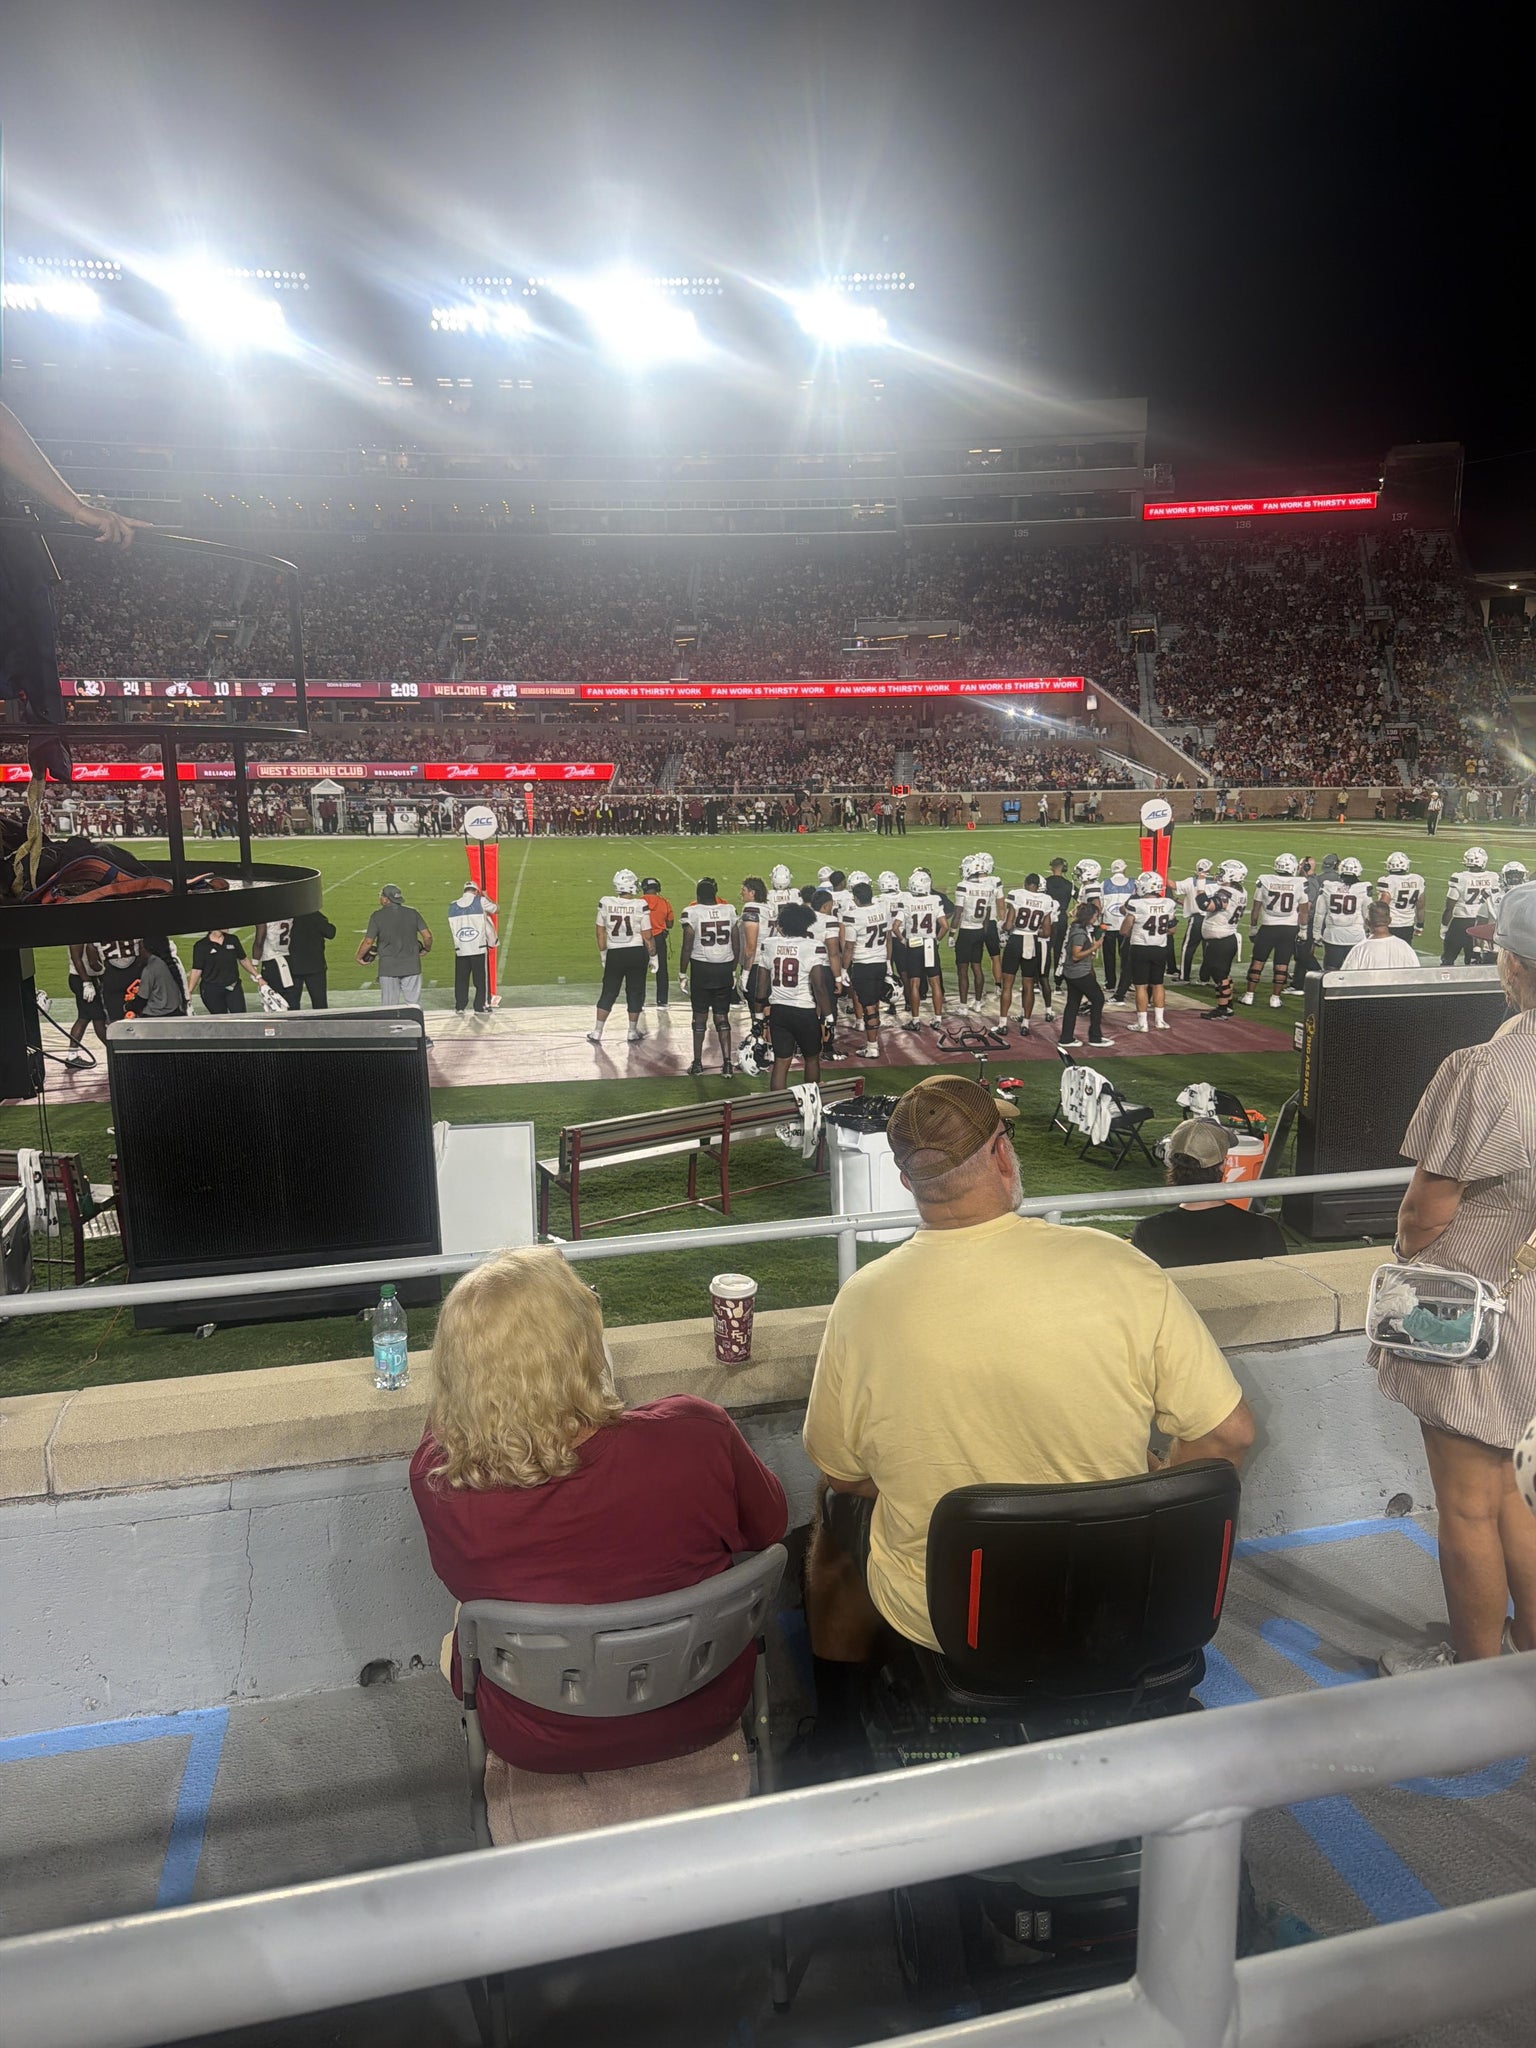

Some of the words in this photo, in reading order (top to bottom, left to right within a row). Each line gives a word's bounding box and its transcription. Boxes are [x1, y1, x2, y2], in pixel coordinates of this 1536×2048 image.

[1197, 504, 1230, 512] THIRSTY
[1392, 513, 1408, 522] 137
[122, 681, 140, 696] 24
[214, 682, 230, 696] 10
[390, 683, 418, 697] 2:09
[434, 686, 487, 695] WELCOME
[1014, 681, 1050, 689] THIRSTY
[260, 767, 288, 775] WEST
[290, 767, 335, 775] SIDELINE
[337, 767, 364, 775] CLUB
[469, 817, 493, 826] ACC
[1146, 809, 1168, 819] ACC
[1267, 891, 1294, 912] 70
[1329, 894, 1357, 915] 50
[1395, 890, 1420, 909] 54
[709, 910, 719, 919] LEE
[974, 899, 986, 918] 6
[610, 915, 633, 936] 71
[911, 913, 932, 934] 14
[1015, 907, 1044, 931] 80
[1143, 914, 1169, 936] 48
[701, 920, 730, 946] 55
[865, 922, 887, 948] 75
[773, 957, 799, 987] 18
[731, 1330, 747, 1344] FSU
